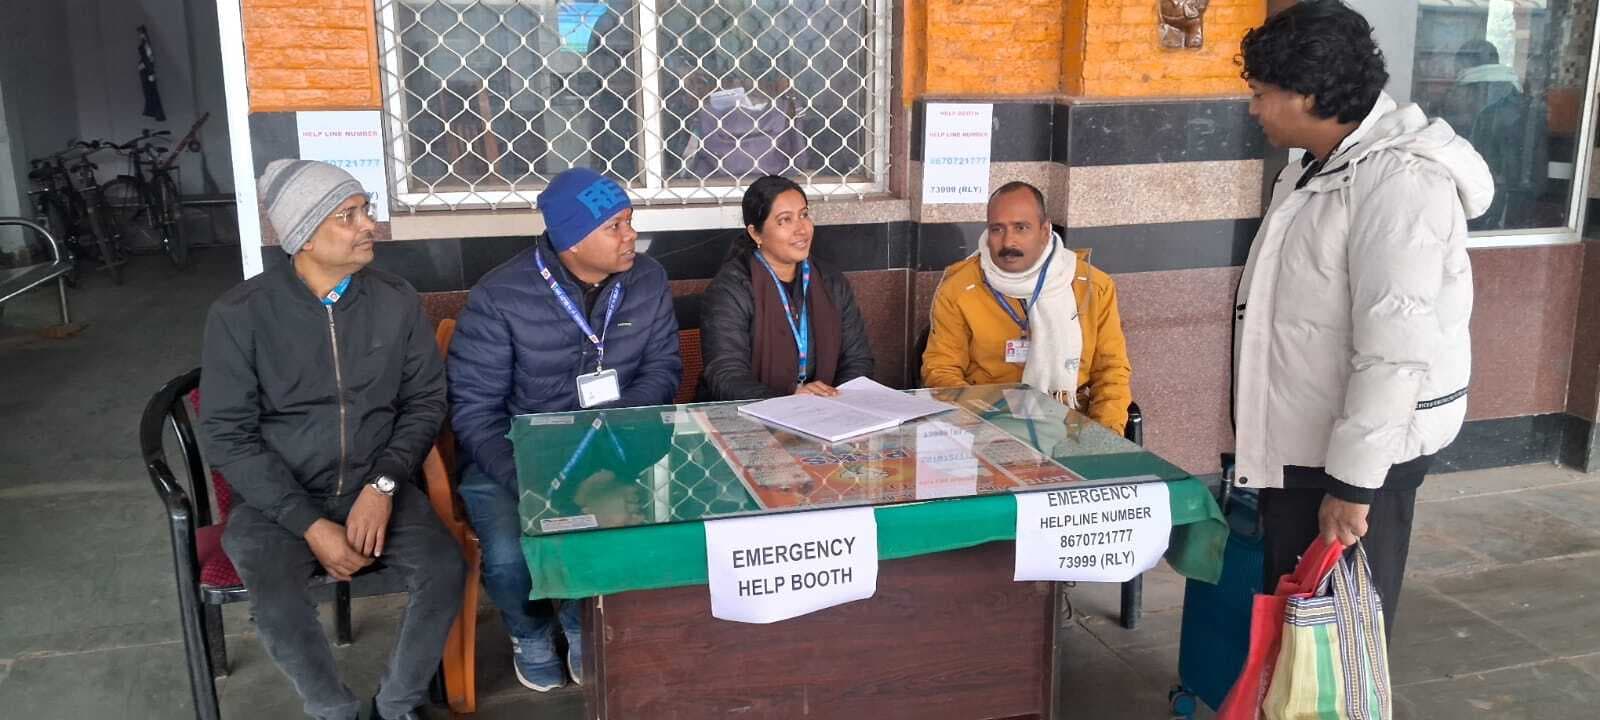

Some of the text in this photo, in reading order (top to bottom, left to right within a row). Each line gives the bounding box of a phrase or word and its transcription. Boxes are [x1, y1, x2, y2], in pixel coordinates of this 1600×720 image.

[1047, 485, 1139, 507] EMERGENCY
[1040, 506, 1152, 529] HELPLINE NUMBER
[1060, 528, 1133, 548] 8670721777
[732, 536, 856, 569] EMERGENCY
[1058, 550, 1135, 570] 73999 (RLY)
[738, 567, 852, 597] HELP BOOTH
